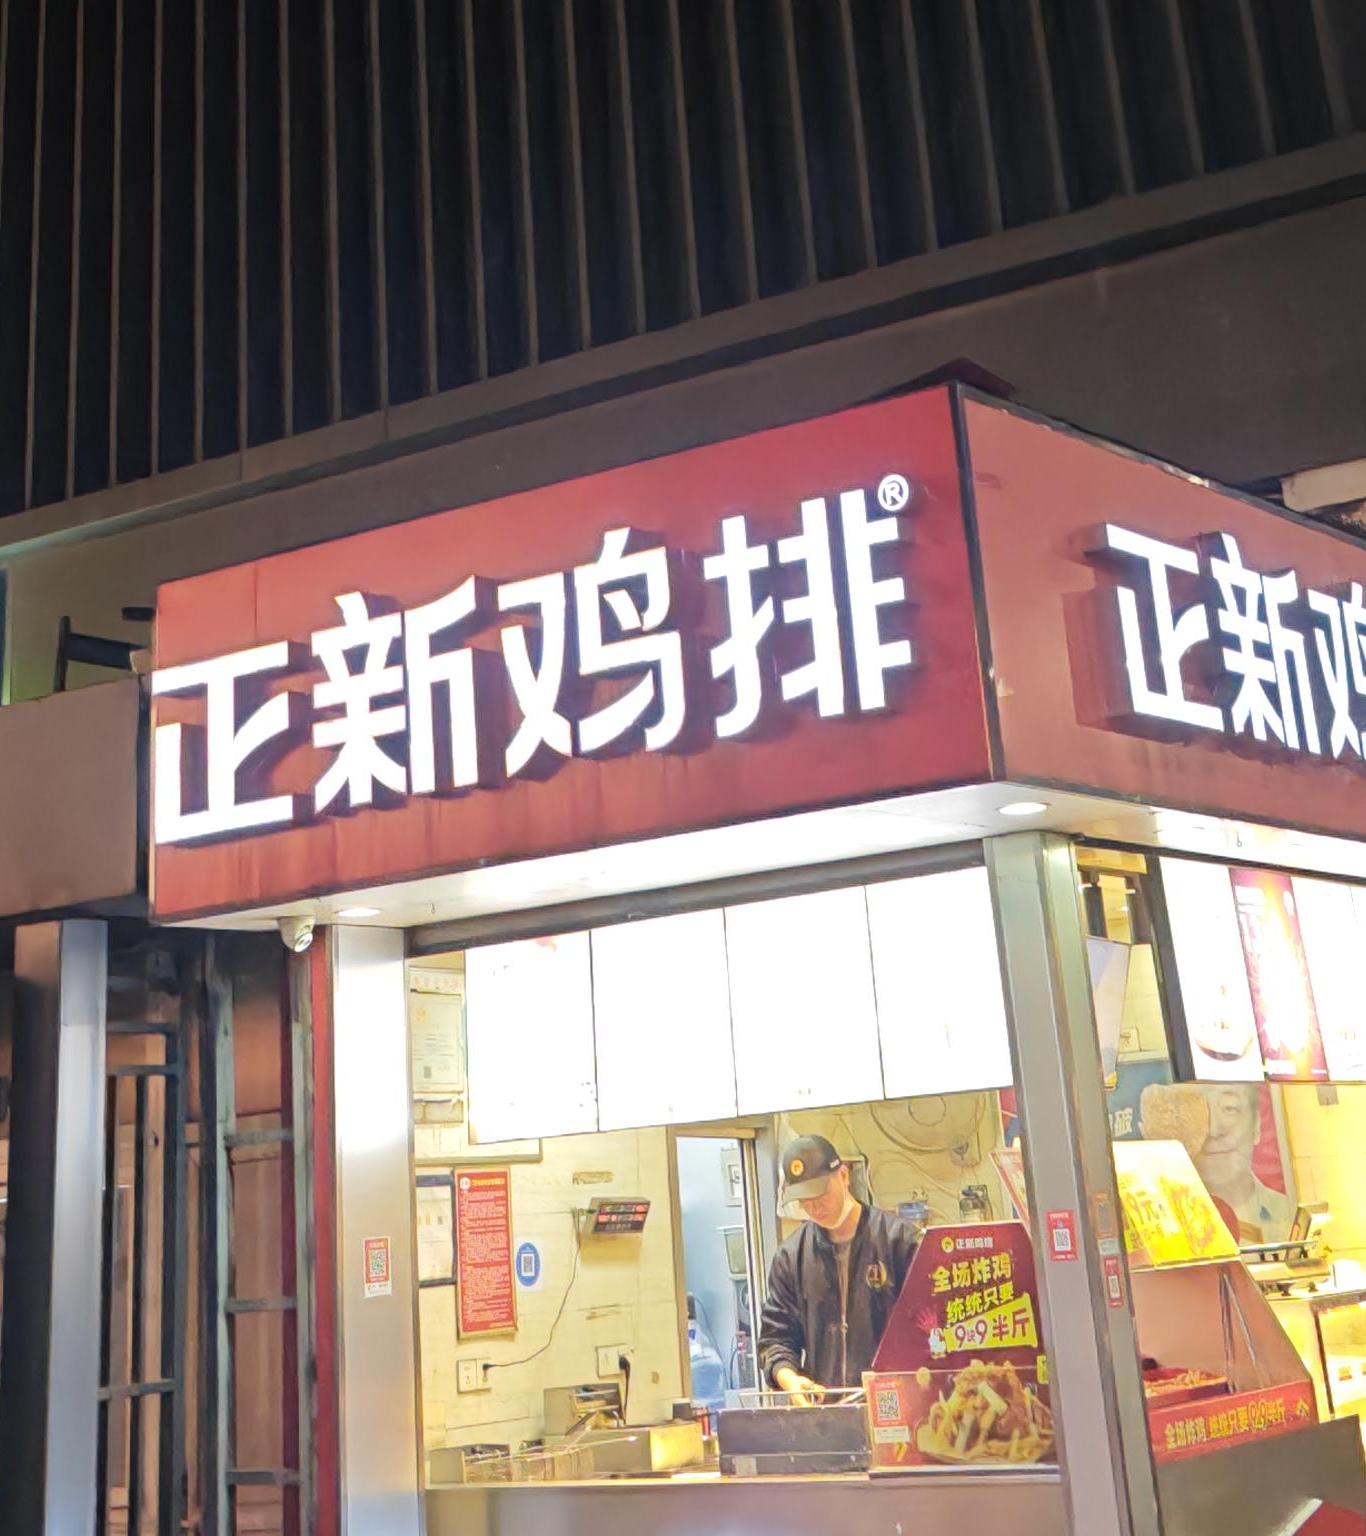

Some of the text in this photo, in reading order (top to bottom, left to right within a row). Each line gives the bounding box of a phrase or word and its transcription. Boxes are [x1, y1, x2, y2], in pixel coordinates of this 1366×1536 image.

[152, 486, 913, 845] 正新鸡排
[931, 1252, 1013, 1294] 全场炸鸡
[946, 1281, 1014, 1325] 统统只要
